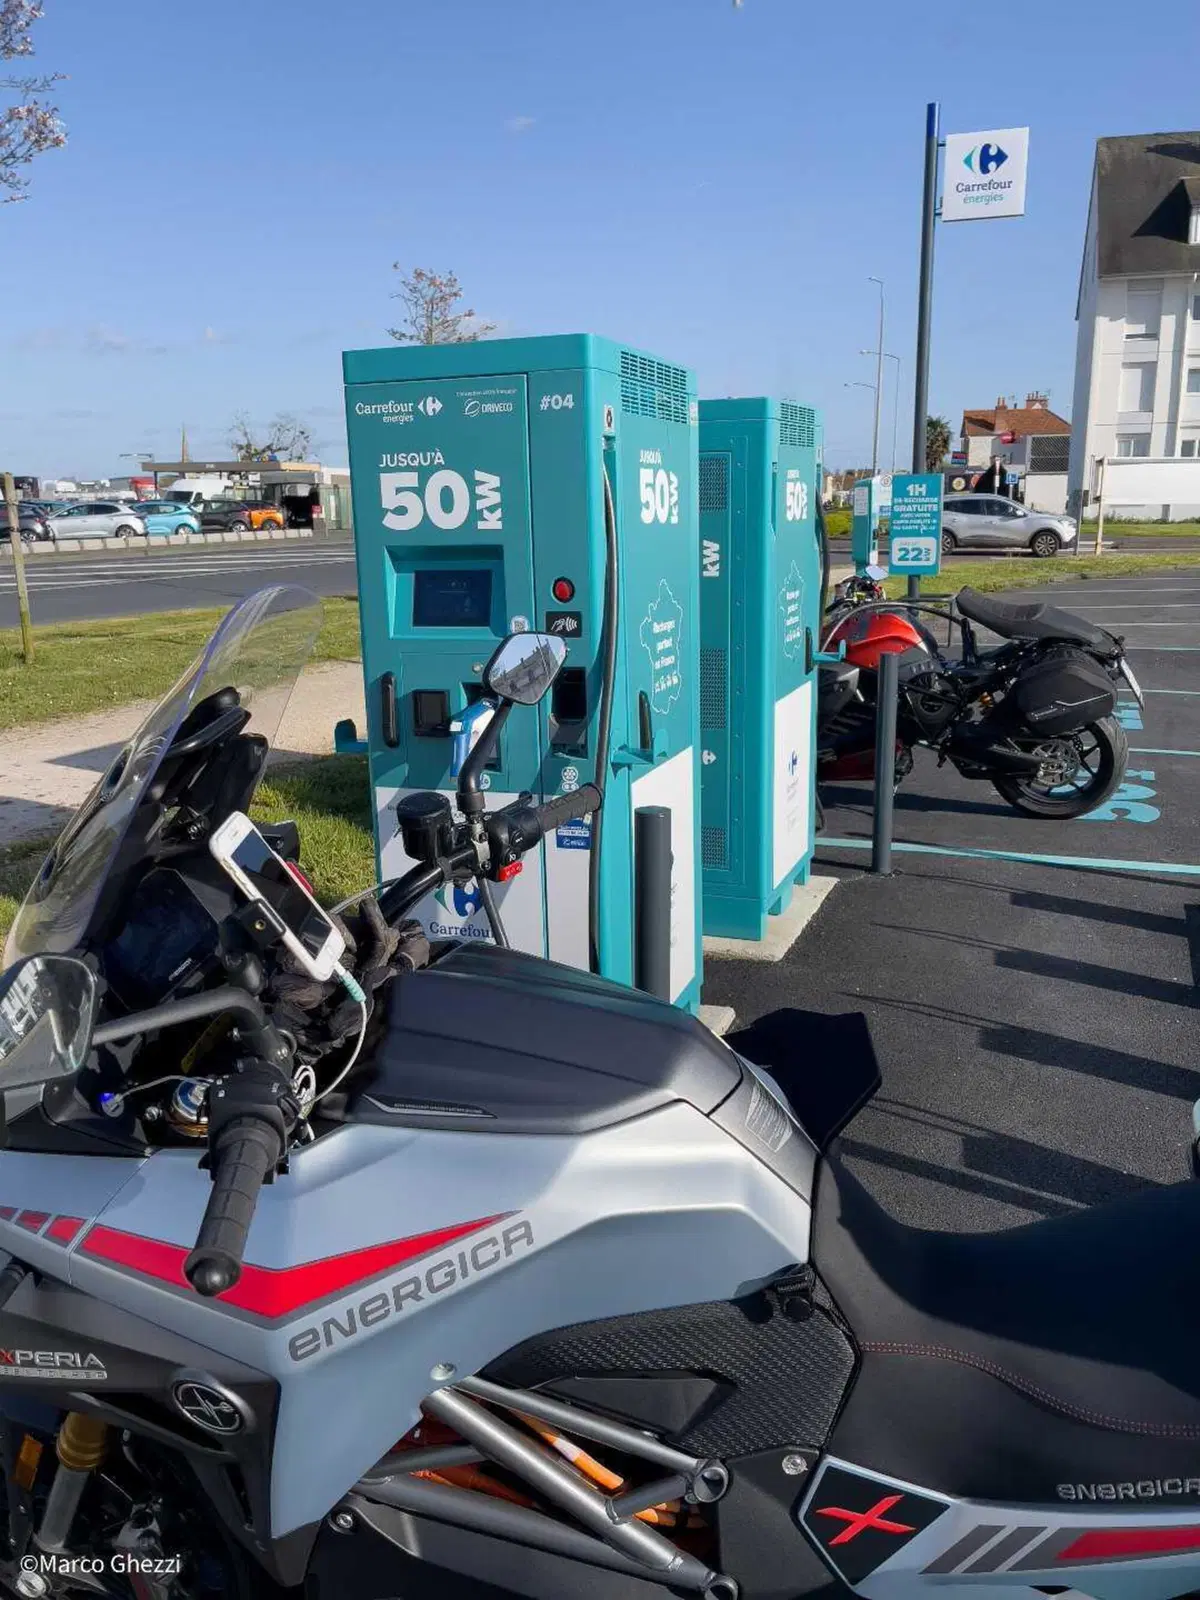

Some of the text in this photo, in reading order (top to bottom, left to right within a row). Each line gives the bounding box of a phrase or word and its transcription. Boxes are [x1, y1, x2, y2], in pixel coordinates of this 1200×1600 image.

[956, 179, 1013, 193] Carrefour
[963, 193, 1004, 205] énergies
[355, 400, 413, 415] Carrefour
[540, 394, 574, 411] #04
[382, 413, 414, 424] énergies
[639, 468, 669, 524] 50
[906, 483, 927, 496] 1H
[380, 469, 470, 530] 50
[786, 481, 802, 521] 50
[893, 503, 938, 511] GRATUITE
[898, 547, 922, 561] 22
[429, 921, 490, 938] Carrefou
